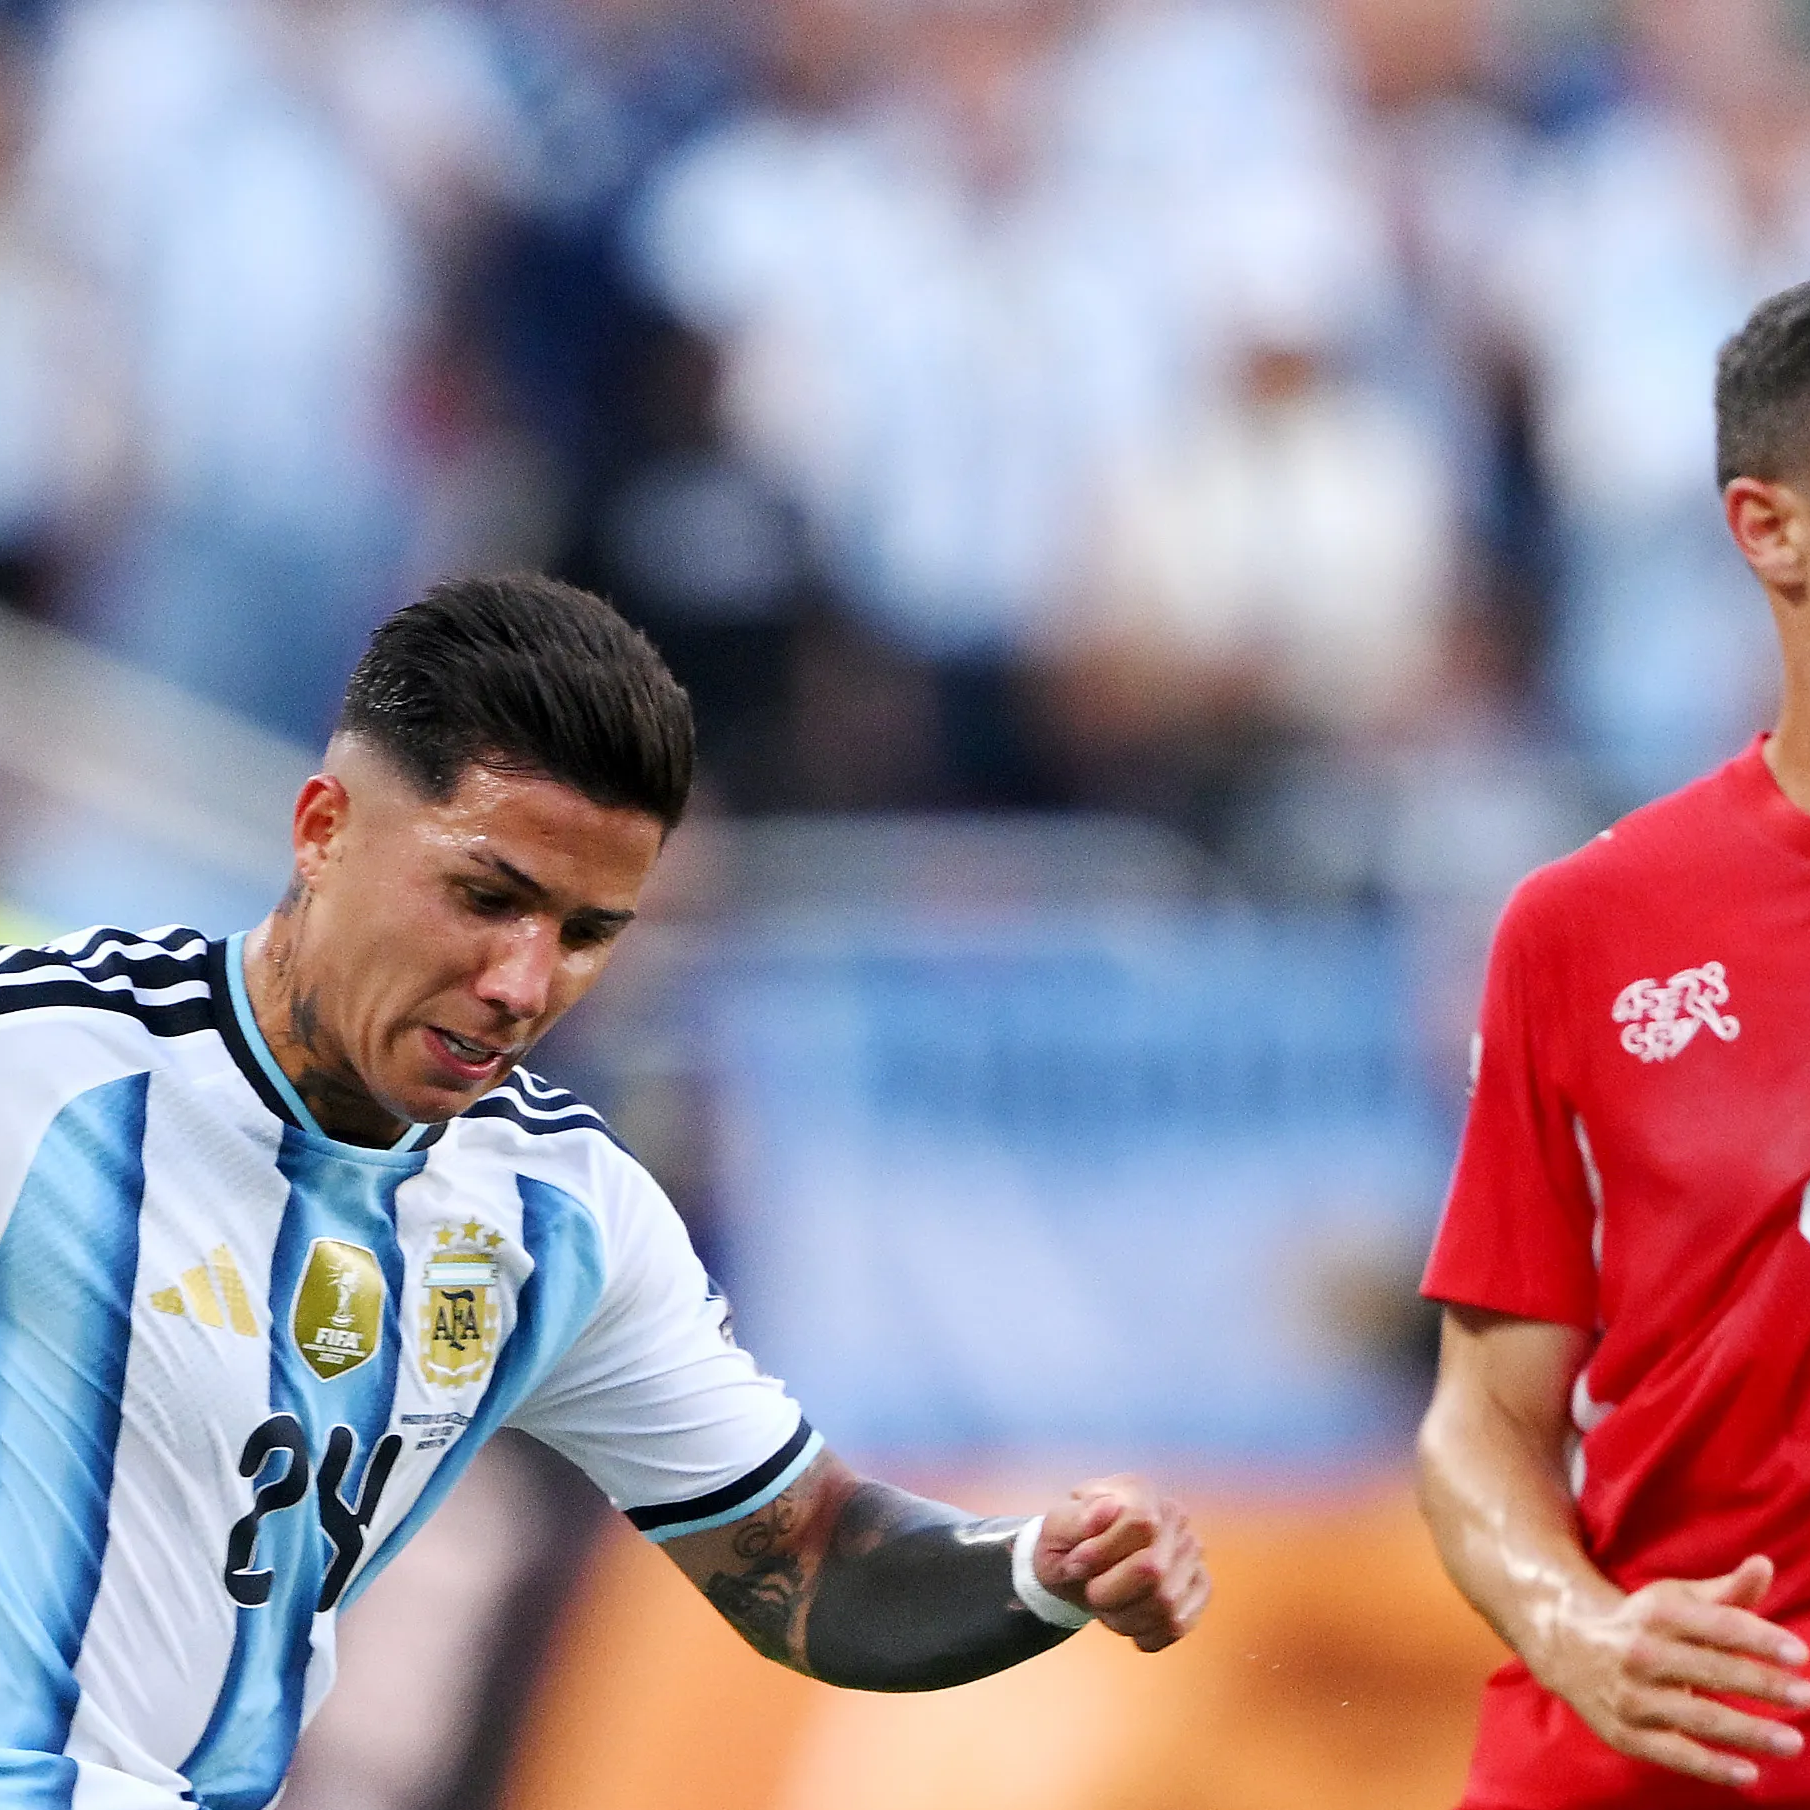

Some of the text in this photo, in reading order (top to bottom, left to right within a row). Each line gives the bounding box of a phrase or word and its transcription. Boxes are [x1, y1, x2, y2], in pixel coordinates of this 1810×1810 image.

[315, 1327, 362, 1350] FIFA
[432, 1289, 480, 1350] AFA
[225, 1414, 403, 1613] 24
